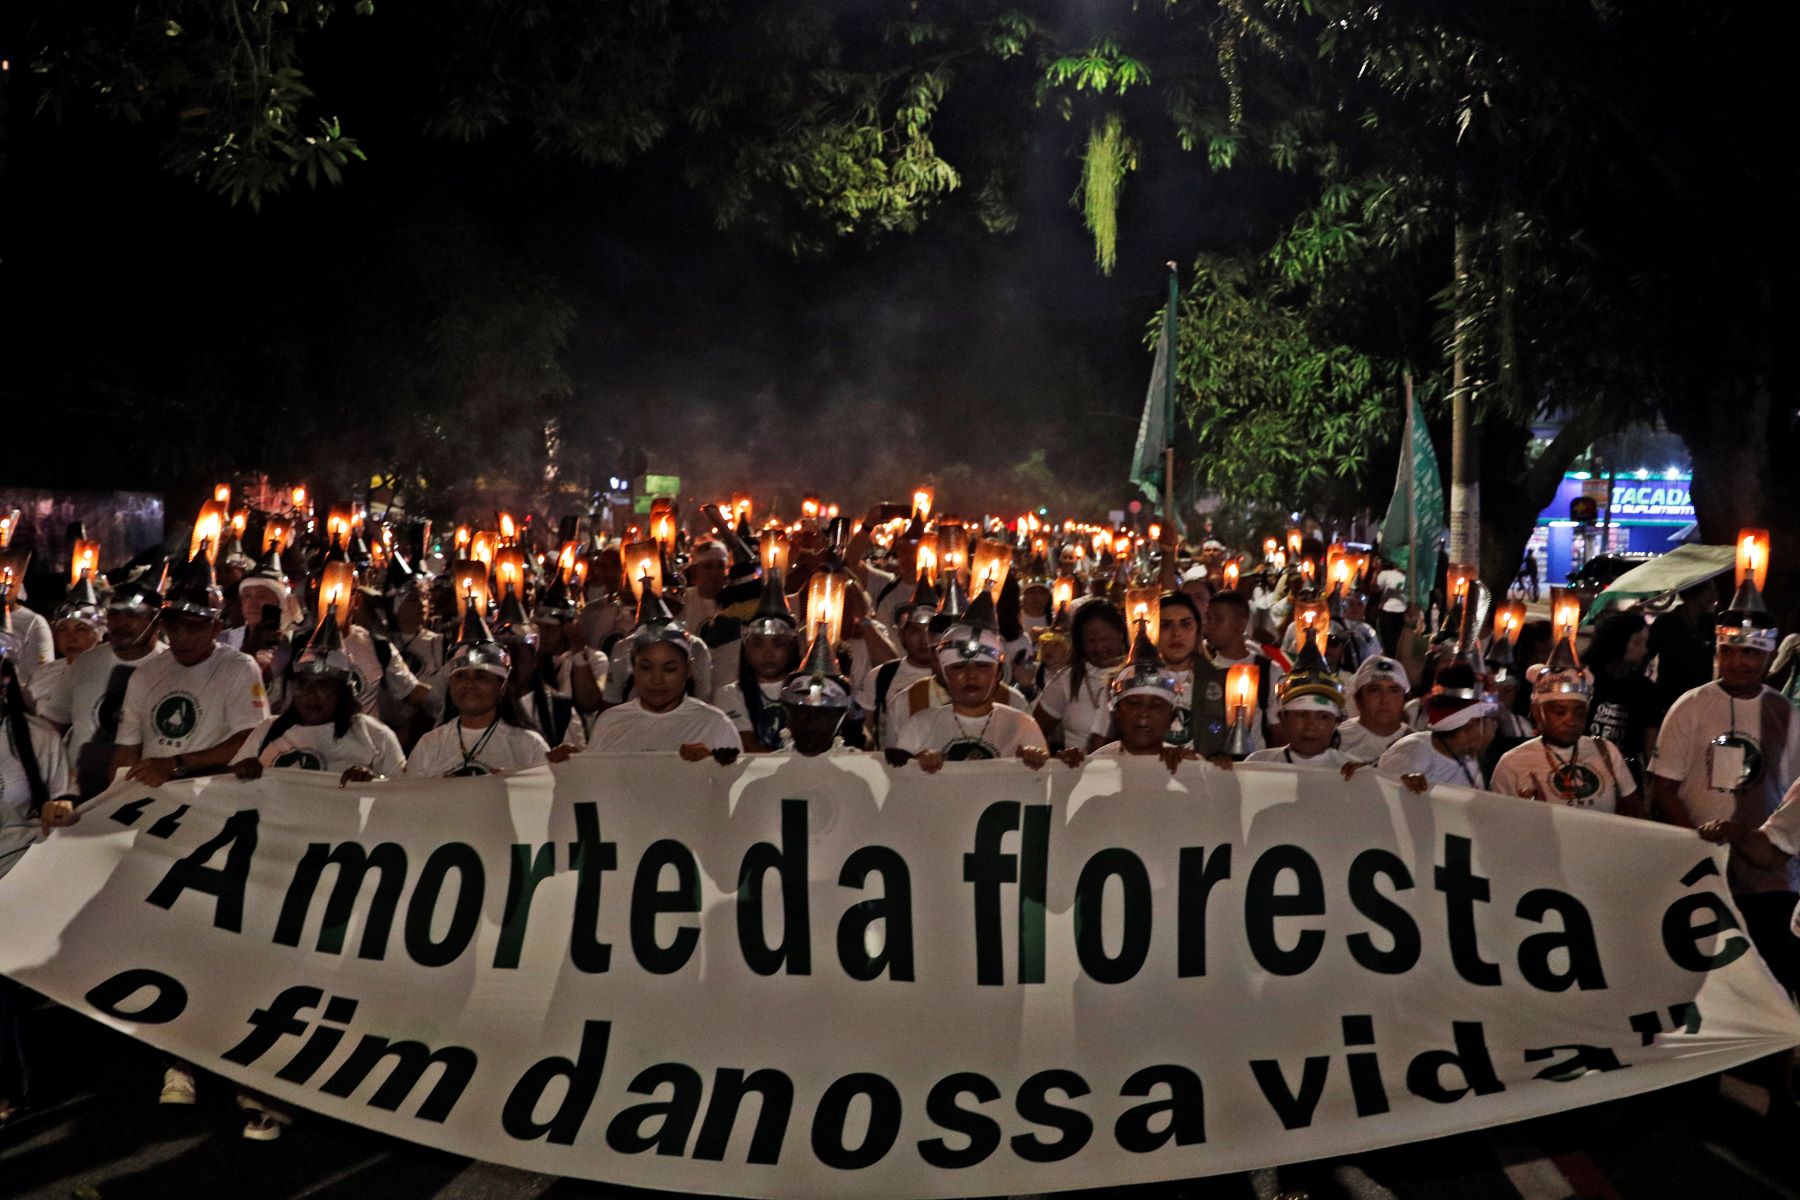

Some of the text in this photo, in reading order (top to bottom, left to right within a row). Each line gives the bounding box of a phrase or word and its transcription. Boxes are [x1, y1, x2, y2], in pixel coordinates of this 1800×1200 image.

[272, 801, 702, 975] morte
[736, 798, 916, 983] da
[963, 800, 1609, 993] floresta
[84, 968, 189, 1025] o
[220, 985, 478, 1124] fim
